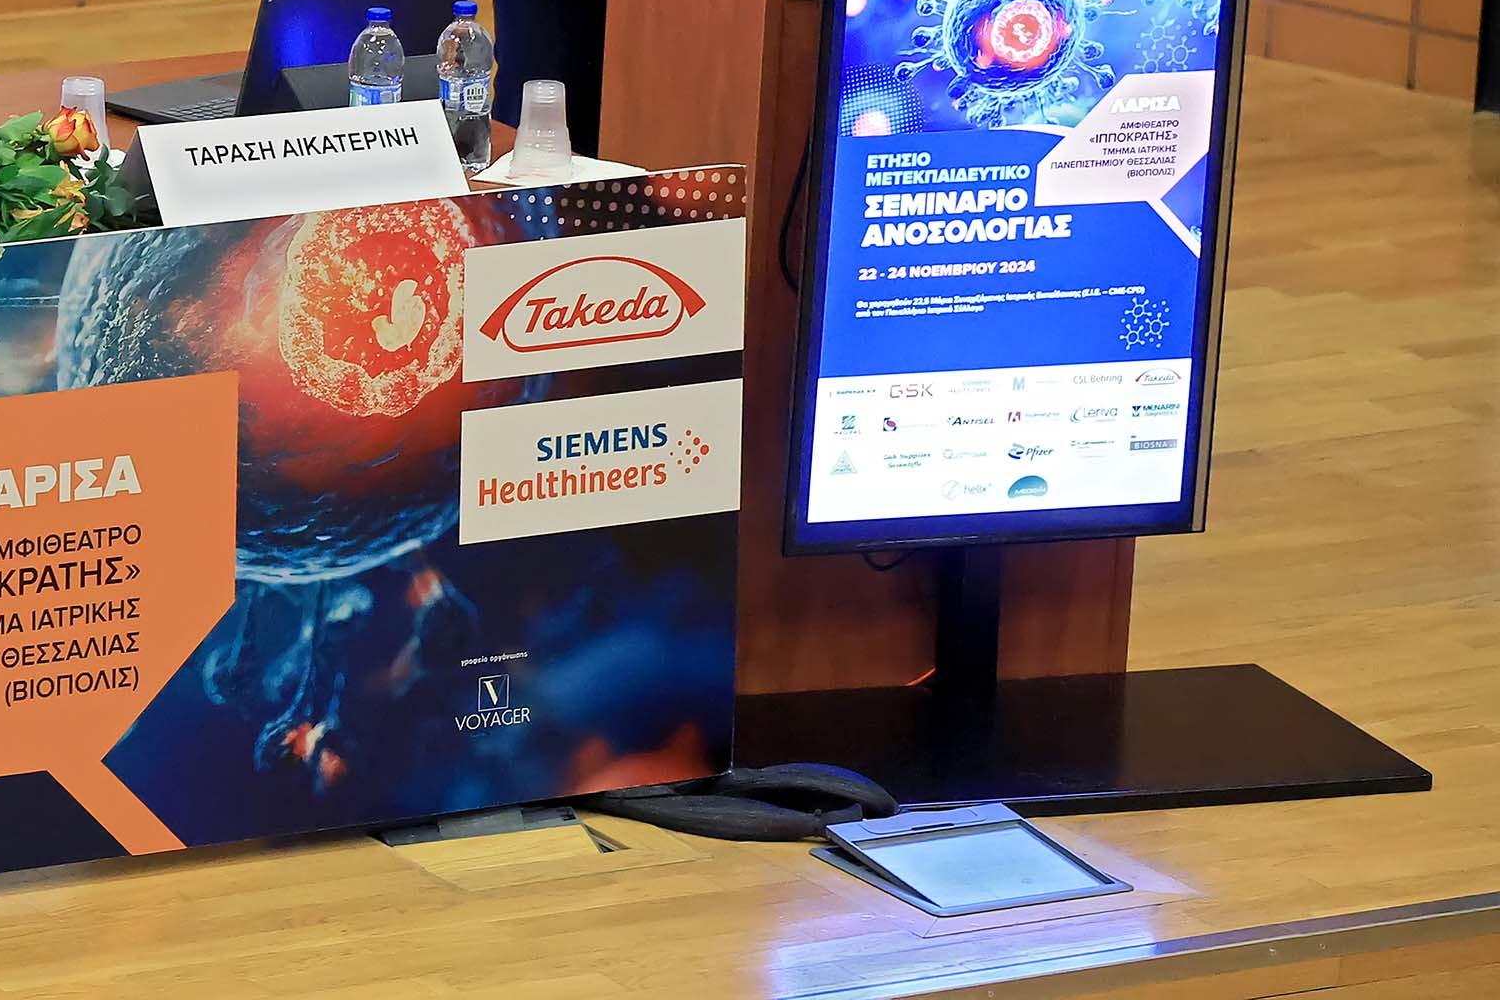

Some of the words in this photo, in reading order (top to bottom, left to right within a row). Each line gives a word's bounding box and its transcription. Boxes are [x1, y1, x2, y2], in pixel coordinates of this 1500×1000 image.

[1120, 120, 1179, 129] ΑΜΦΙΘΕΑΤΡΟ
[184, 140, 278, 168] ΤΑΡΑΣΗ
[282, 126, 420, 159] ΑΙΚΑΤΕΡΙΝΗ
[1089, 130, 1178, 143] «ΙΠΠΟΚΡΑΤΗΣ»
[866, 151, 931, 170] ΕΤΗΣΙΟ
[1102, 147, 1136, 156] ΤΜΗΜΑ
[1137, 144, 1178, 154] ΙΑΤΡΙΚΗΣ
[1050, 158, 1125, 170] ΠΑΝΕΠΙΣΤΗΜΙΟΥ
[1126, 156, 1177, 166] ΘΕΣΣΑΛΙΑΣ
[1127, 168, 1176, 179] (ΒΙΟΠΟΛΙΣ)
[865, 165, 1031, 188] ΜΕΤΕΚΠΑΙΔΕΥΤΙΚΟ
[863, 188, 1029, 219] ΣΕΜΙΝΑΡΙΟ
[860, 214, 1074, 248] ΑΝΟΣΟΛΟΓΙΑΣ
[857, 267, 877, 281] 22
[888, 265, 907, 280] 24
[909, 261, 998, 279] ΝΟΕΜΒΡΙΟΥ
[999, 259, 1036, 274] 2024
[523, 286, 670, 334] Takeda
[889, 383, 933, 399] GSK
[536, 423, 668, 462] SIEMENS
[1026, 445, 1054, 461] Pfizer
[478, 460, 668, 507] Healthineers
[31, 597, 141, 632] ΙΑΤΡΙΚΗΣ
[1, 632, 140, 668] ΘΕΣΣΑΛΙΑΣ
[4, 666, 140, 706] (ΒΙΟΠΟΛΙΣ)
[454, 707, 531, 731] VOYAGER
